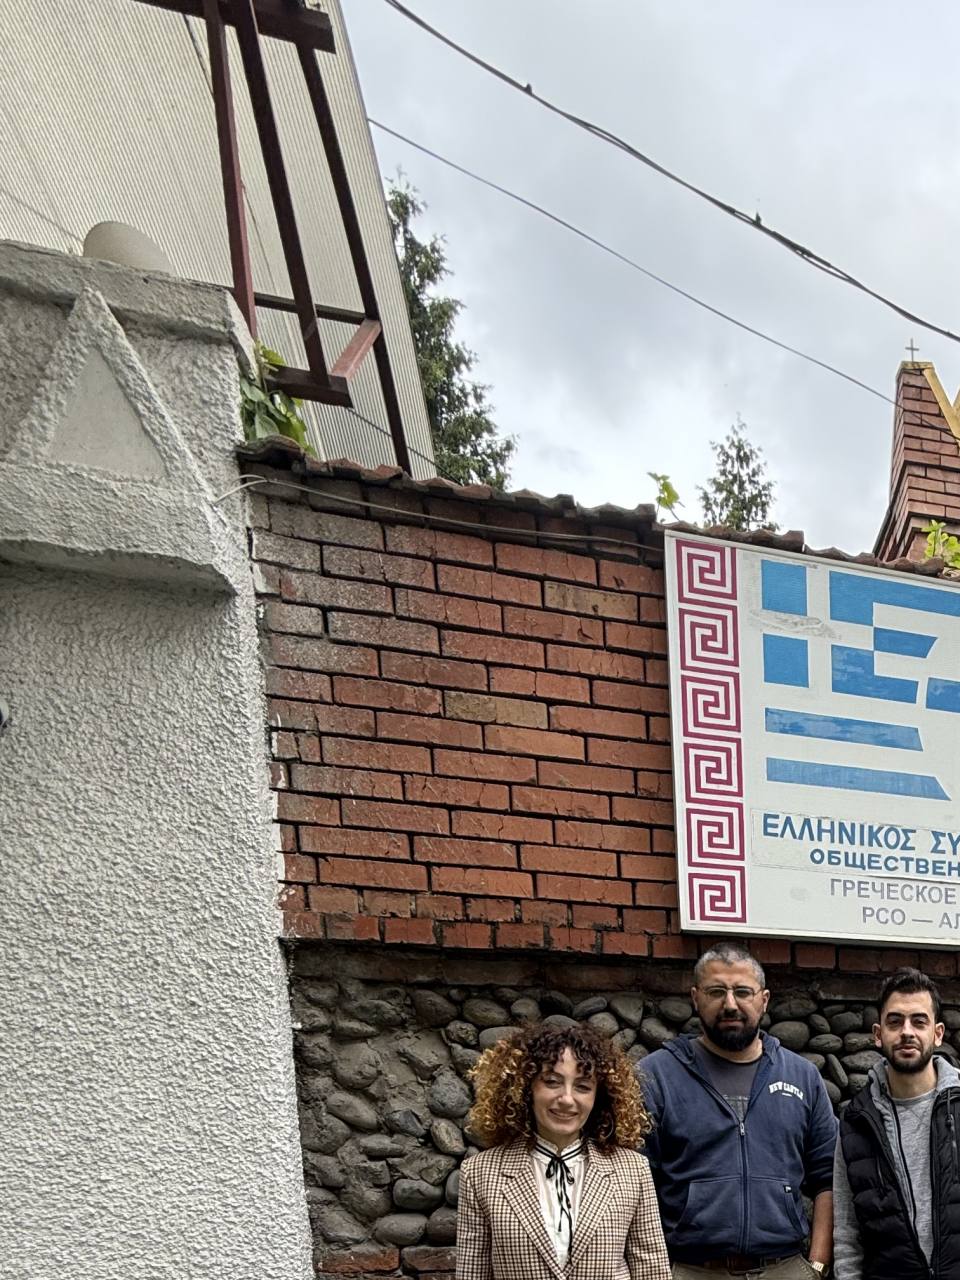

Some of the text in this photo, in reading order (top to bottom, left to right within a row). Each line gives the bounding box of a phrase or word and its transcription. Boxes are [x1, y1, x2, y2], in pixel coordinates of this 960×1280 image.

[762, 813, 916, 851] ΕΛΛΗΝΙΚΟΣ
[830, 878, 956, 905] ГРЕЧЕСКОЕ
[862, 906, 906, 926] РСО
